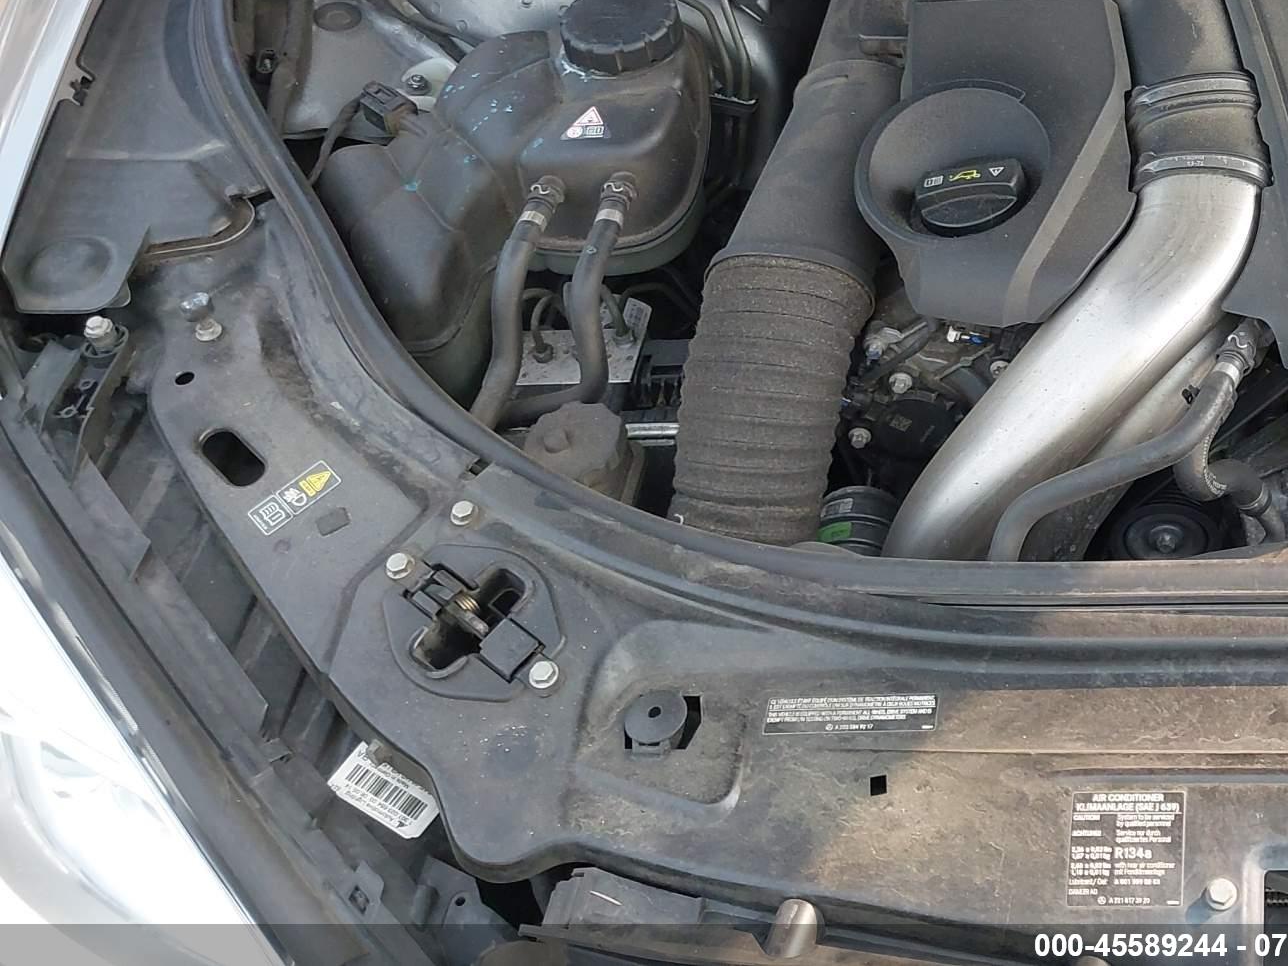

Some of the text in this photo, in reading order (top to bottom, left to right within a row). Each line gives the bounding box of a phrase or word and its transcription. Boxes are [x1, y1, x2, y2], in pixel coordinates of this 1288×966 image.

[1092, 793, 1165, 802] AIR CONDITIONER
[1076, 803, 1135, 812] KLIMAANLAGE
[1113, 847, 1152, 859] R134a
